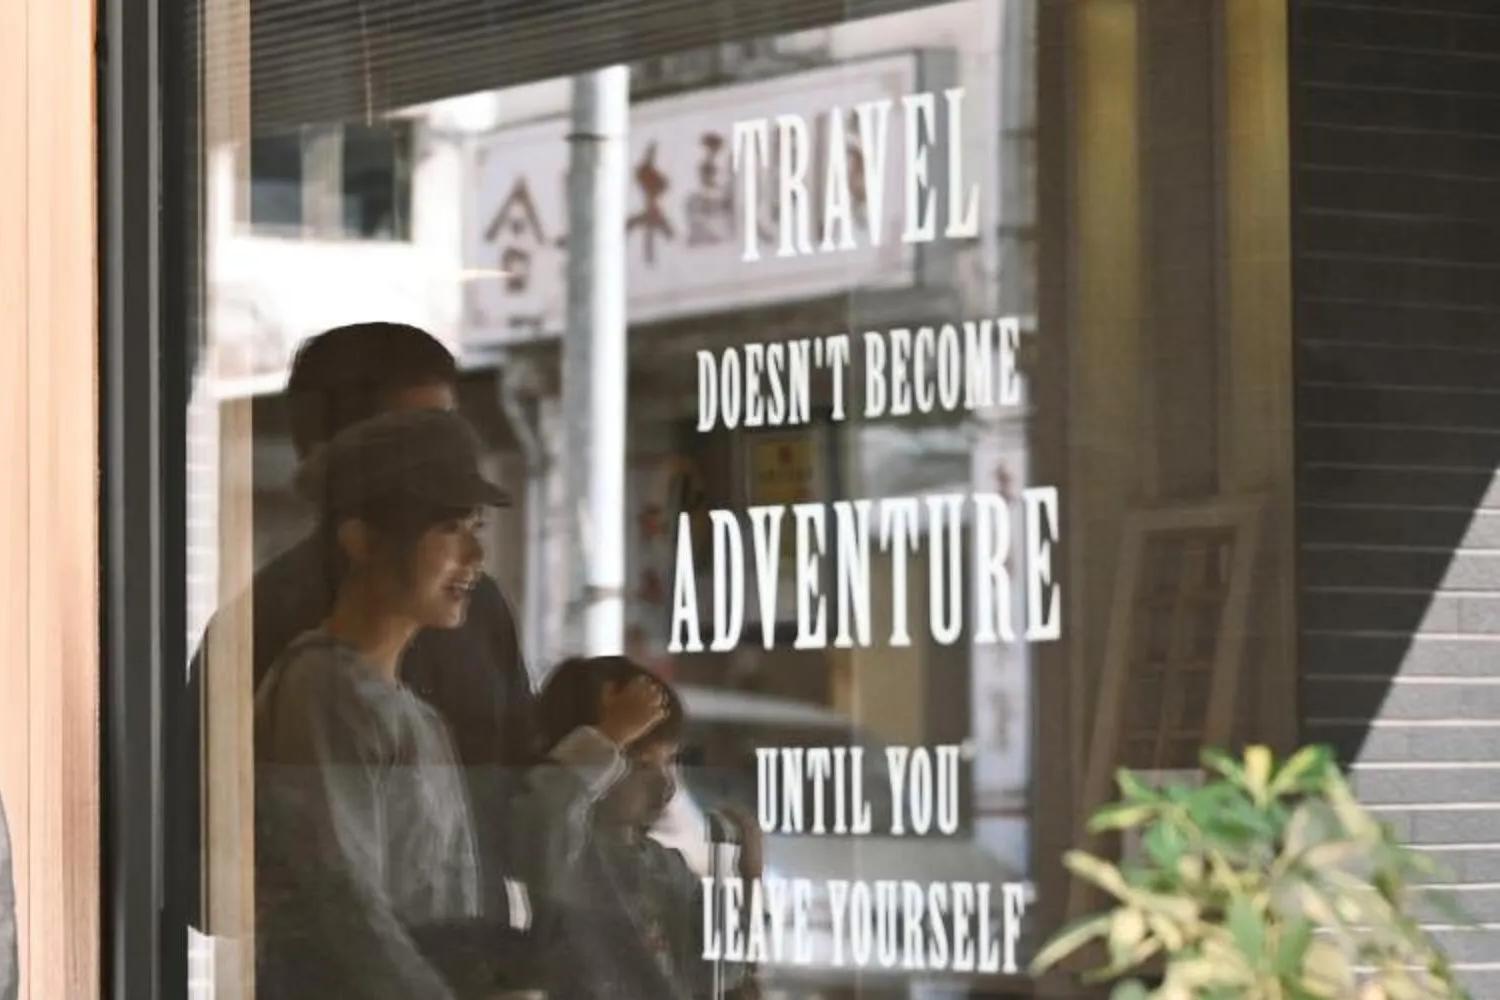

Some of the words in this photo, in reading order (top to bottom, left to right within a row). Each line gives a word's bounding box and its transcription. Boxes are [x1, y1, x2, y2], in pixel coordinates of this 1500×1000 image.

[732, 87, 980, 262] TRAVEL
[697, 334, 850, 432] DOESN'T
[862, 317, 1021, 418] BECOME
[669, 485, 1061, 653] ADVENTURE
[756, 747, 871, 834] UNTIL
[884, 745, 960, 835] YOU
[702, 877, 812, 963] LEAVE
[826, 879, 1026, 973] YOURSELF
